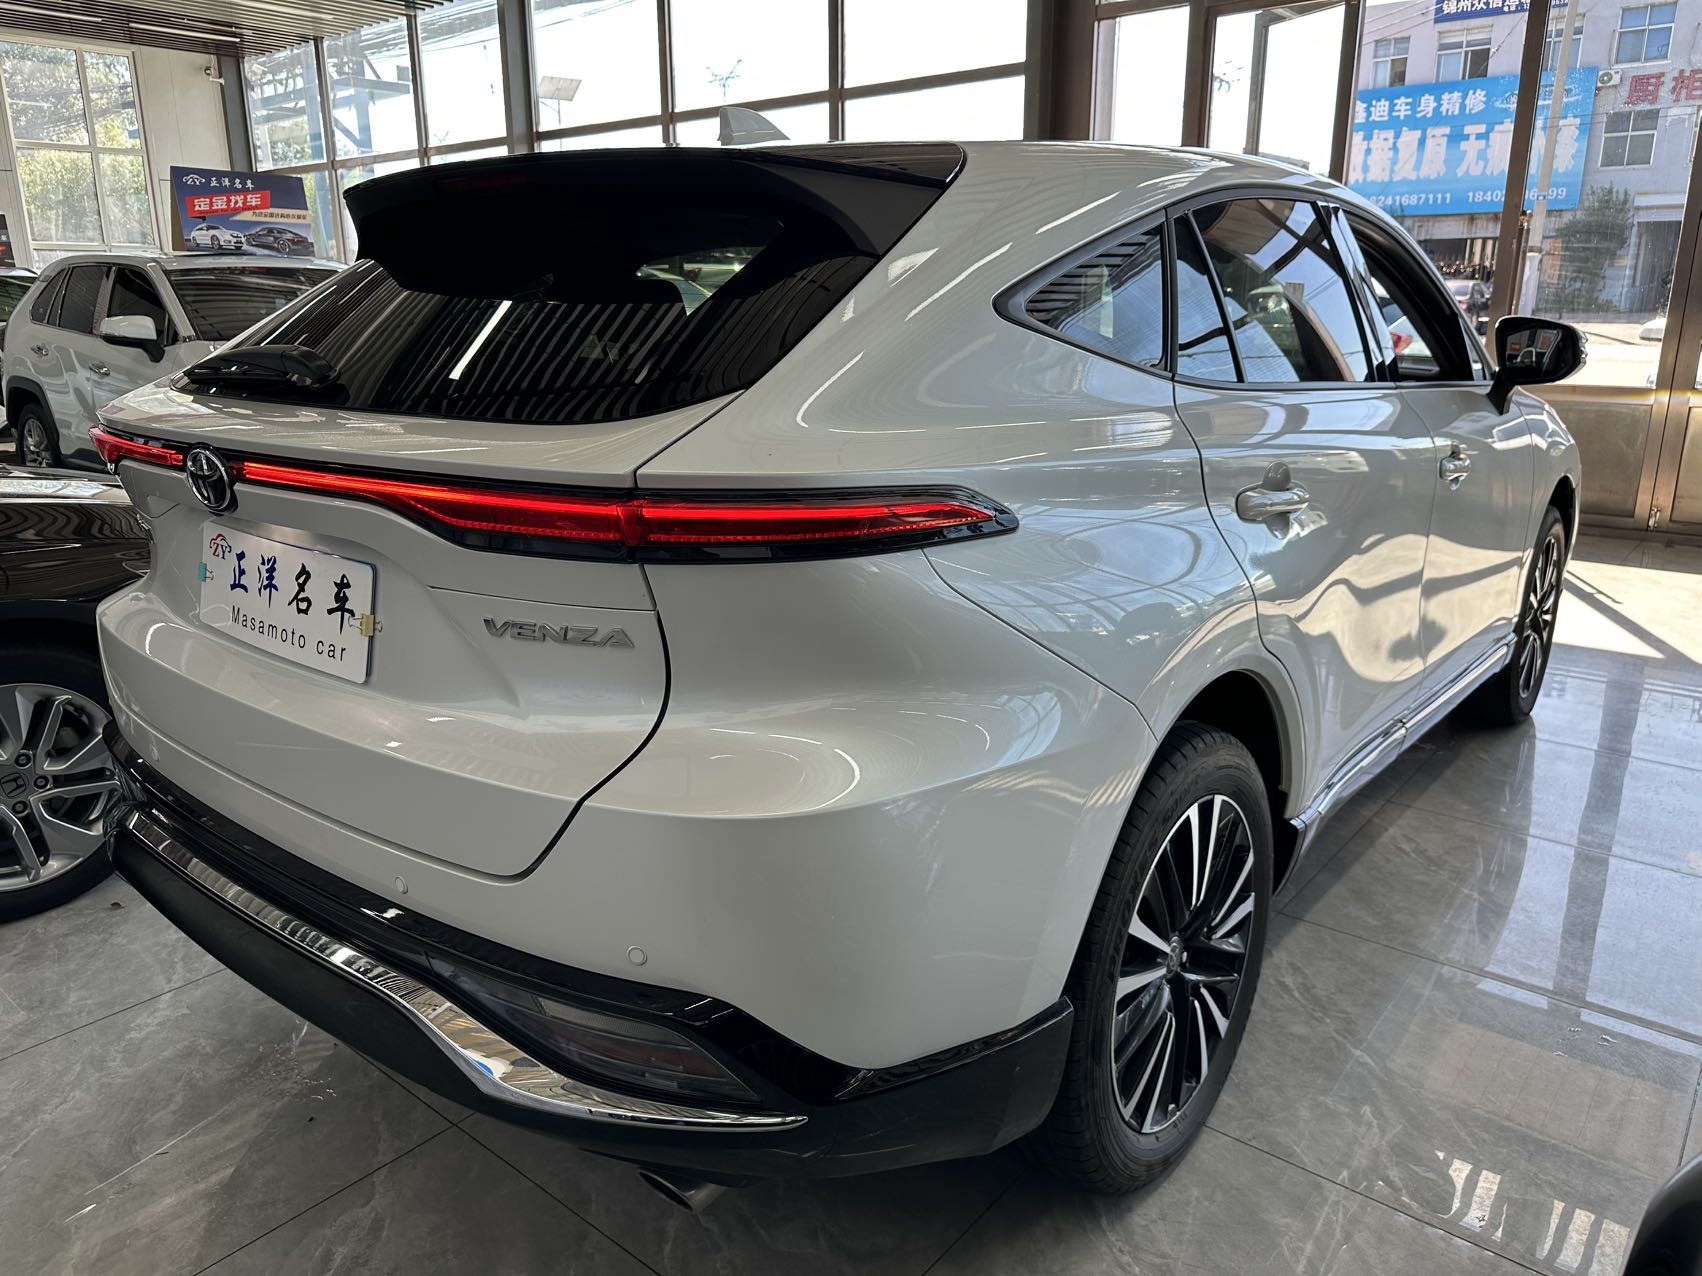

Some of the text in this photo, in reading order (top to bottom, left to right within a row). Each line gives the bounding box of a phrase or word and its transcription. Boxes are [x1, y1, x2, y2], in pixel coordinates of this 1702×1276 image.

[194, 194, 261, 211] 定金找车
[230, 550, 356, 635] 正洋名车
[231, 605, 347, 662] Masamoto car
[483, 616, 635, 649] VENZA
